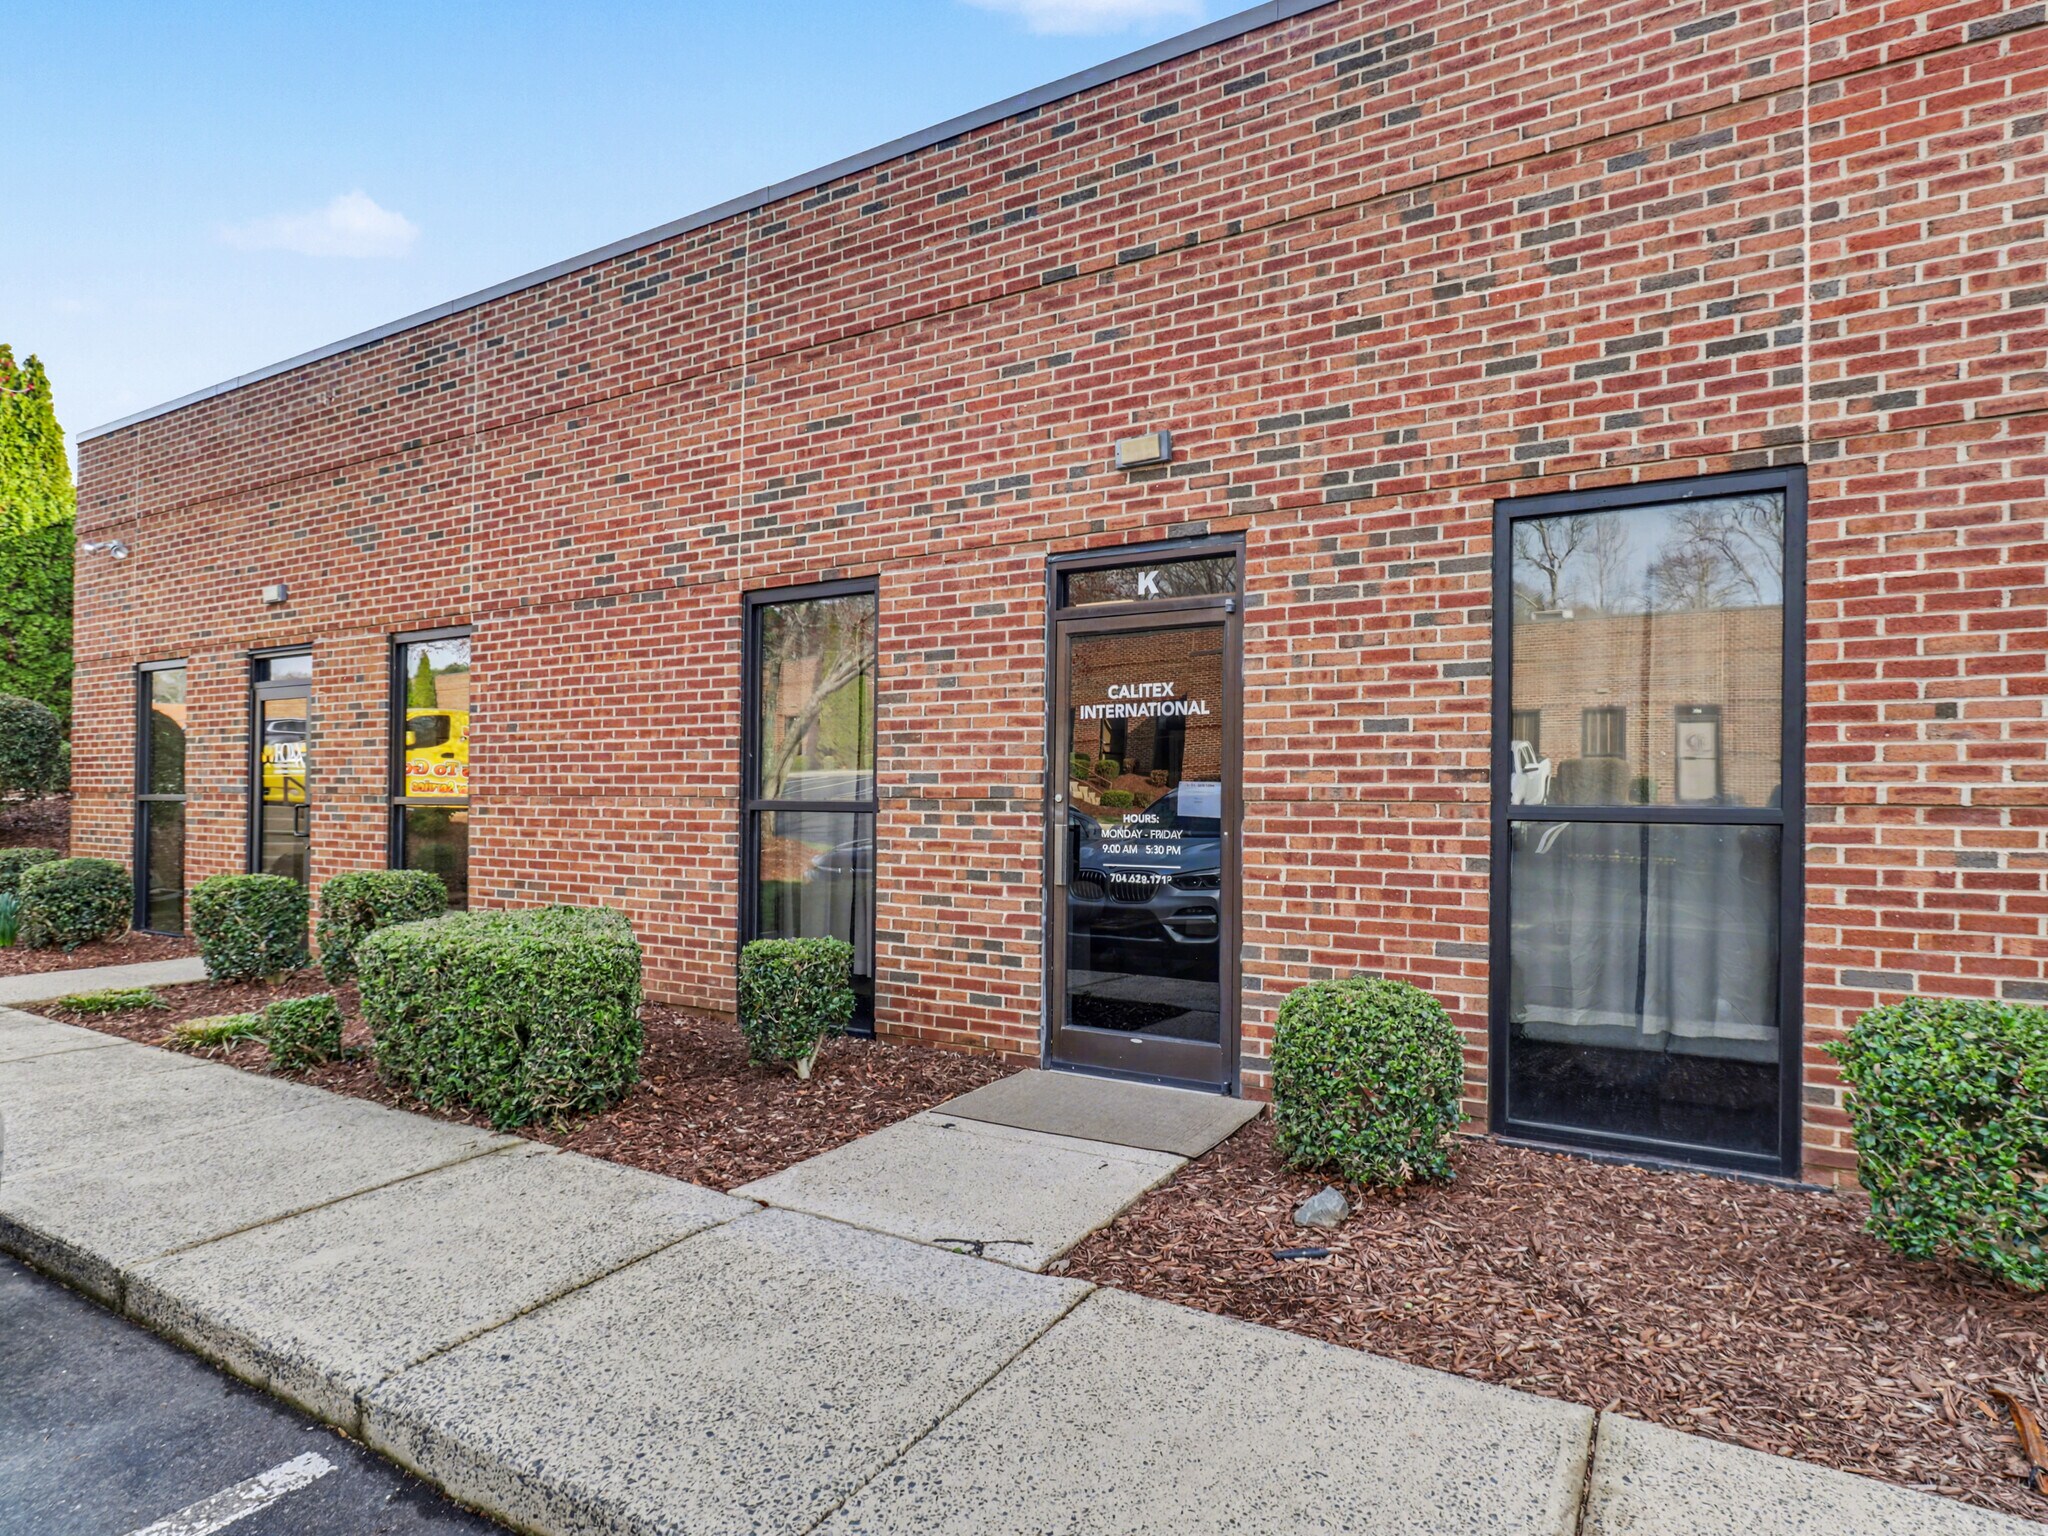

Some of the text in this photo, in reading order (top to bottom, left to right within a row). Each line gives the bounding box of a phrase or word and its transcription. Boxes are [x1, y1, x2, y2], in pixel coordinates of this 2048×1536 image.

[1138, 570, 1160, 596] K
[1107, 682, 1175, 700] CALITEX
[1080, 700, 1210, 720] INTERNATIONAL
[1122, 813, 1160, 824] HOURS:
[1101, 829, 1143, 840] MONDAY
[1150, 829, 1184, 840] FRIDAY
[1121, 845, 1138, 855] AM
[1145, 845, 1165, 855] 5:30
[1165, 845, 1181, 856] PM
